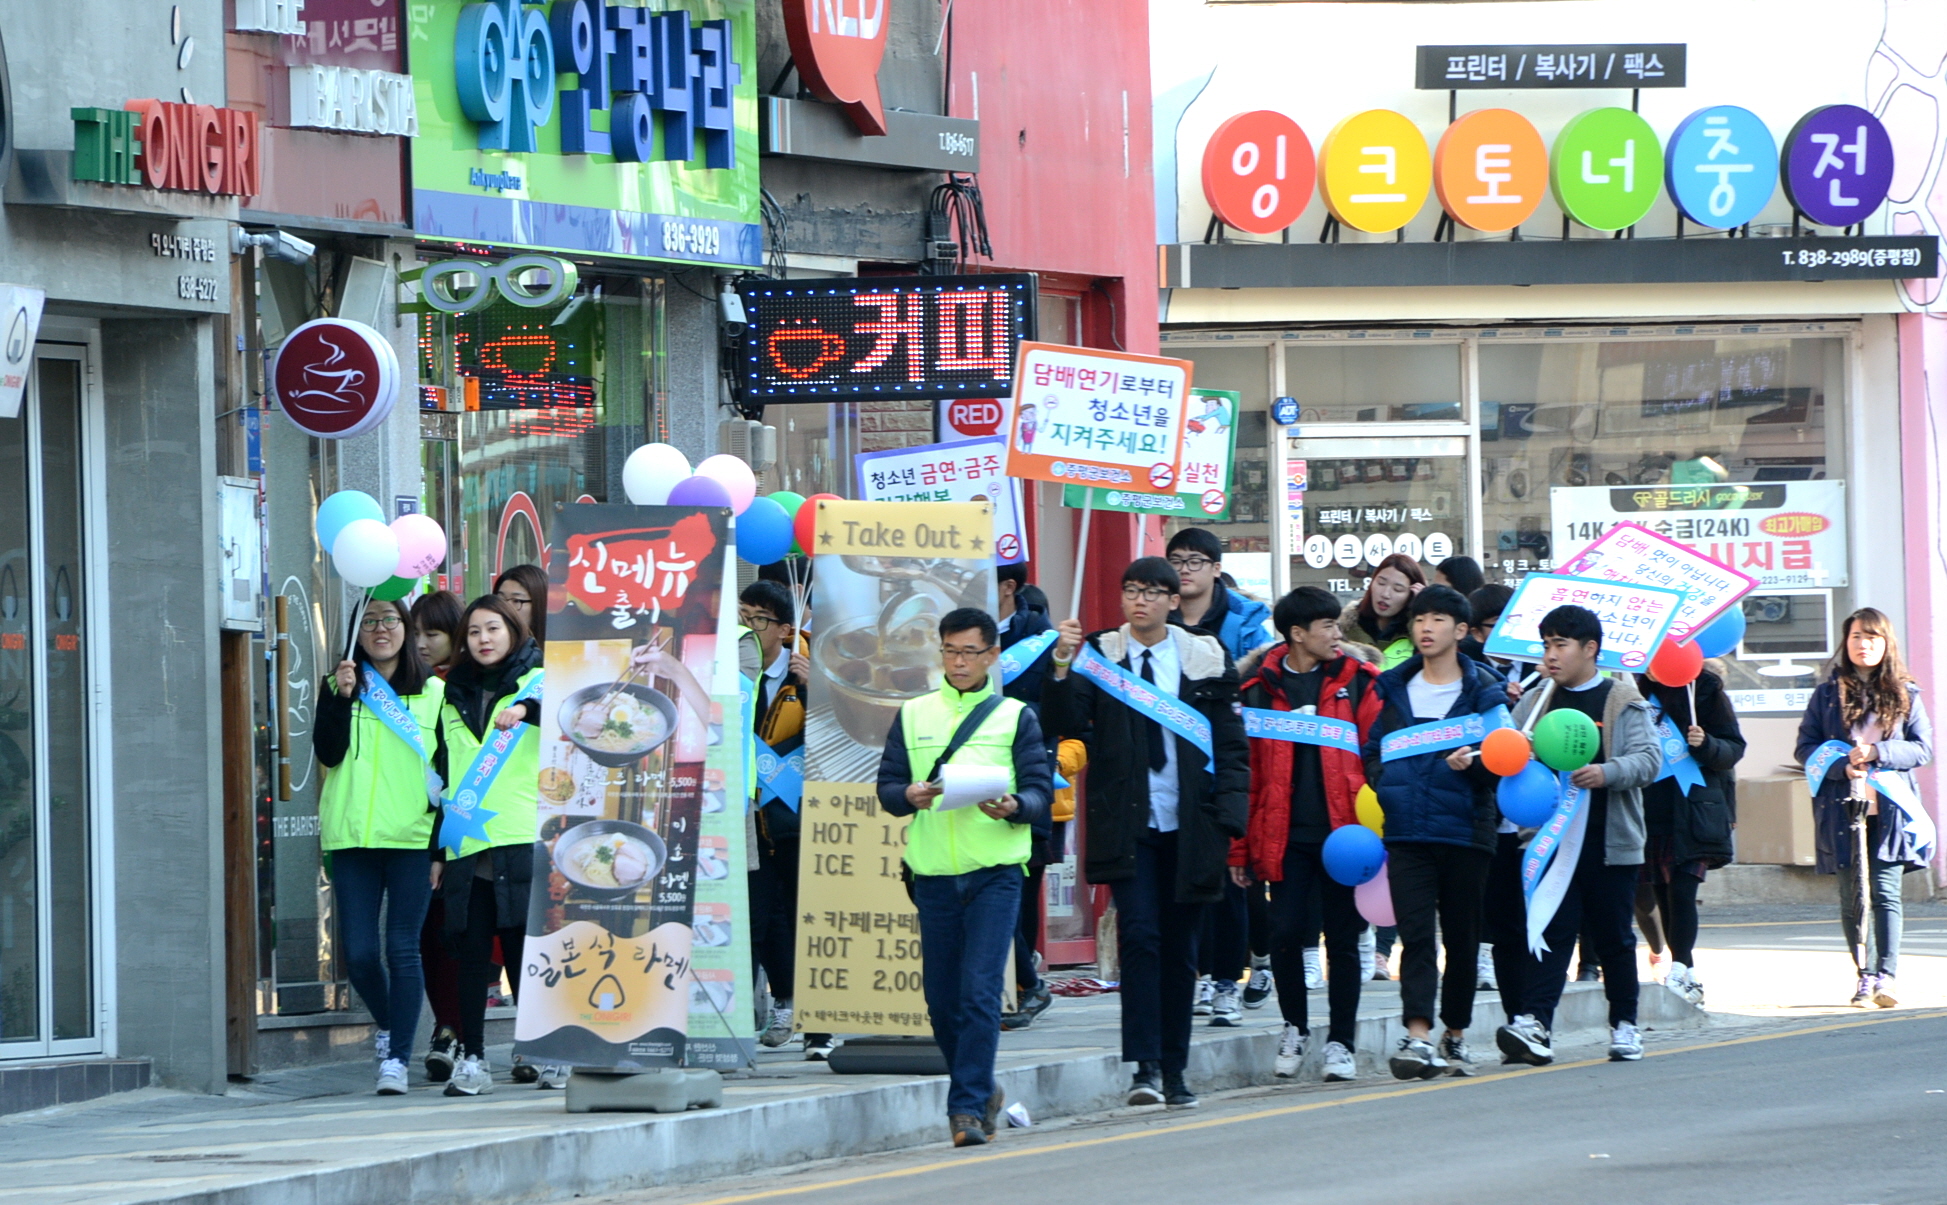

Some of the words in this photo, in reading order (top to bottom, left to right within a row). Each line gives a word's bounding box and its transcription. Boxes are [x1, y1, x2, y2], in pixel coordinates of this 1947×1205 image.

[1445, 54, 1507, 81] 프린터
[1534, 53, 1596, 80] 복사기
[1623, 53, 1665, 79] 팩스
[551, 0, 741, 170] 안경나라
[298, 64, 419, 137] BARISTA
[71, 106, 143, 185] THE
[130, 99, 260, 197] ONIGIRI
[1231, 117, 1869, 219] 잉크토너충전
[662, 221, 720, 256] 836-3929
[1033, 362, 1175, 399] 담배연기로부터
[953, 403, 1000, 426] RED
[1087, 398, 1171, 428] 청소년을
[1050, 422, 1168, 455] 지켜주세요!
[870, 467, 916, 491] 청소년
[1653, 489, 1711, 509] 골드러시
[1319, 509, 1352, 524] 프린터
[1364, 508, 1398, 523] 복사기
[1410, 507, 1433, 522] 팩스
[1765, 516, 1824, 535] 최고가매입
[842, 520, 906, 548] Take
[914, 522, 961, 550] Out
[1566, 521, 1601, 541] 14K
[569, 540, 696, 598] 신메뉴
[1615, 534, 1650, 557] 담배,
[1649, 549, 1680, 570] 멋이
[1680, 563, 1731, 594] 아닙니다.
[1634, 563, 1674, 587] 당신의
[611, 589, 661, 630] 출시
[1551, 587, 1622, 606] 흡연하지
[1626, 596, 1664, 614] 않는
[1593, 610, 1656, 630] 소년이
[272, 816, 289, 836] THE
[812, 822, 858, 845] HOT
[814, 853, 855, 876] ICE
[808, 936, 852, 958] HOT
[527, 932, 615, 988] 일본식
[632, 943, 690, 991] 라멘
[809, 967, 849, 990] ICE
